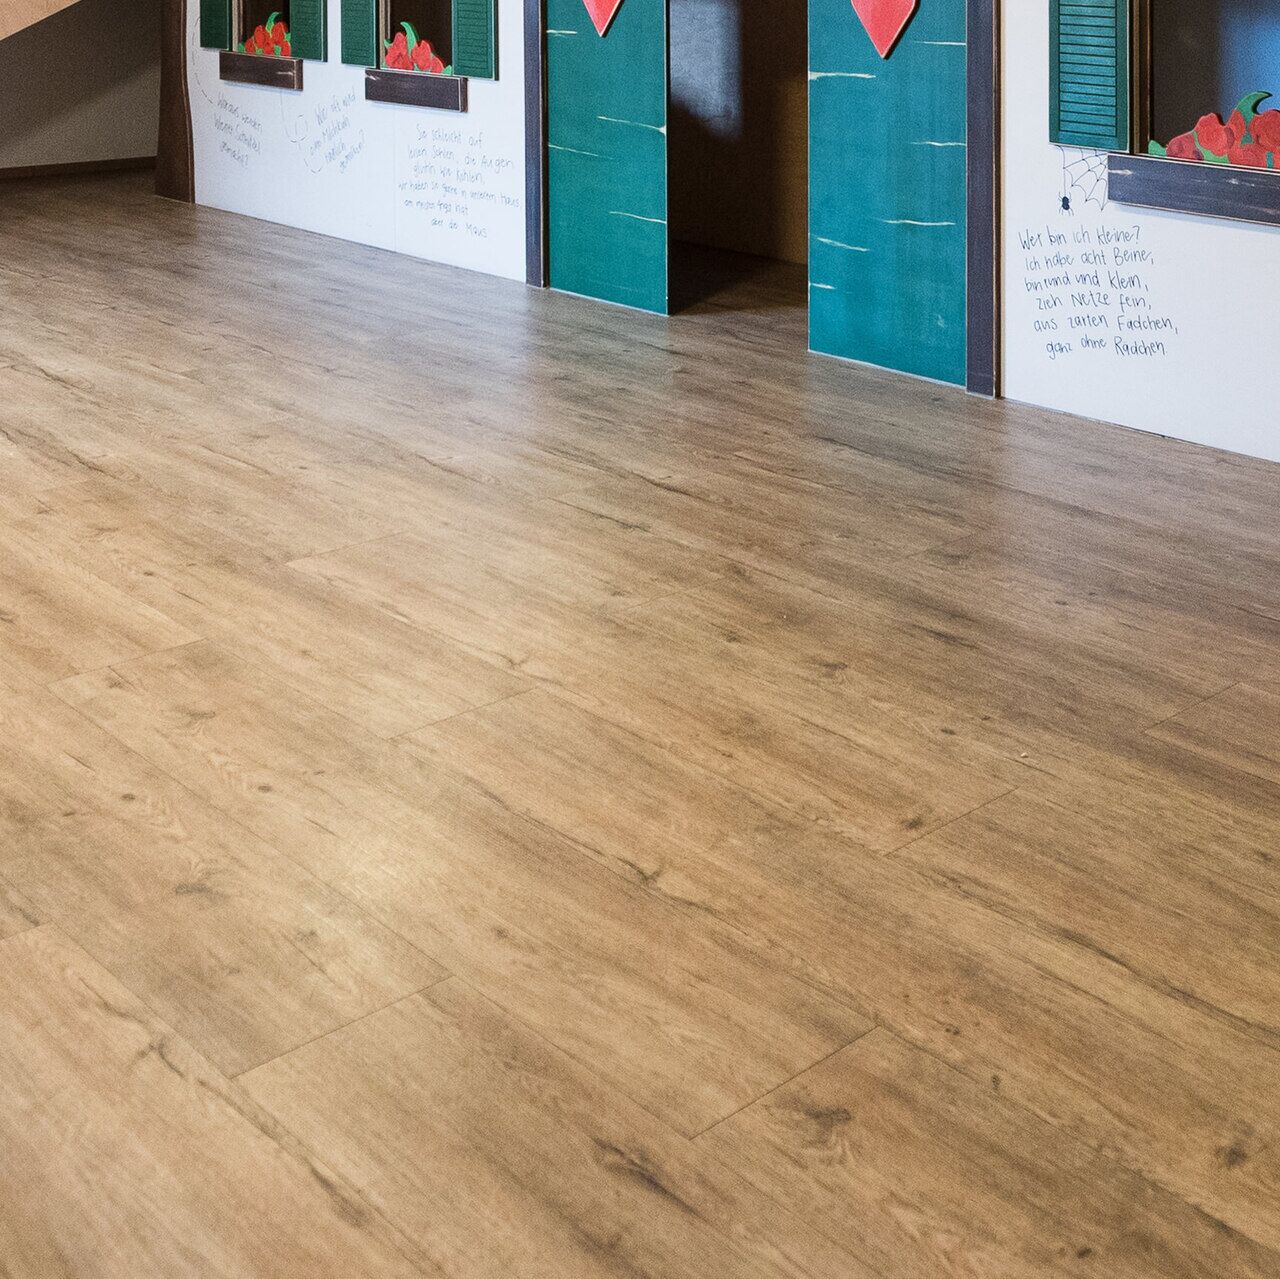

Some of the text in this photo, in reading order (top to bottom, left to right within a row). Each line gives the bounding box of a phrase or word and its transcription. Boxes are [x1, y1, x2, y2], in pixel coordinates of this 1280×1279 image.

[1018, 228, 1043, 251] Wer
[1046, 224, 1068, 246] bin
[1072, 224, 1091, 244] ich
[1044, 251, 1074, 270] habe
[1080, 249, 1107, 265] acht
[1113, 246, 1155, 266] Beine,
[1024, 277, 1043, 292] bin
[1043, 271, 1071, 288] rund
[1075, 269, 1100, 287] und
[1070, 290, 1111, 308] Netze
[1119, 293, 1152, 313] fein,
[1033, 317, 1059, 332] aus
[1068, 313, 1109, 329] zarten
[1046, 342, 1073, 361] ganz
[1080, 333, 1107, 349] ohne
